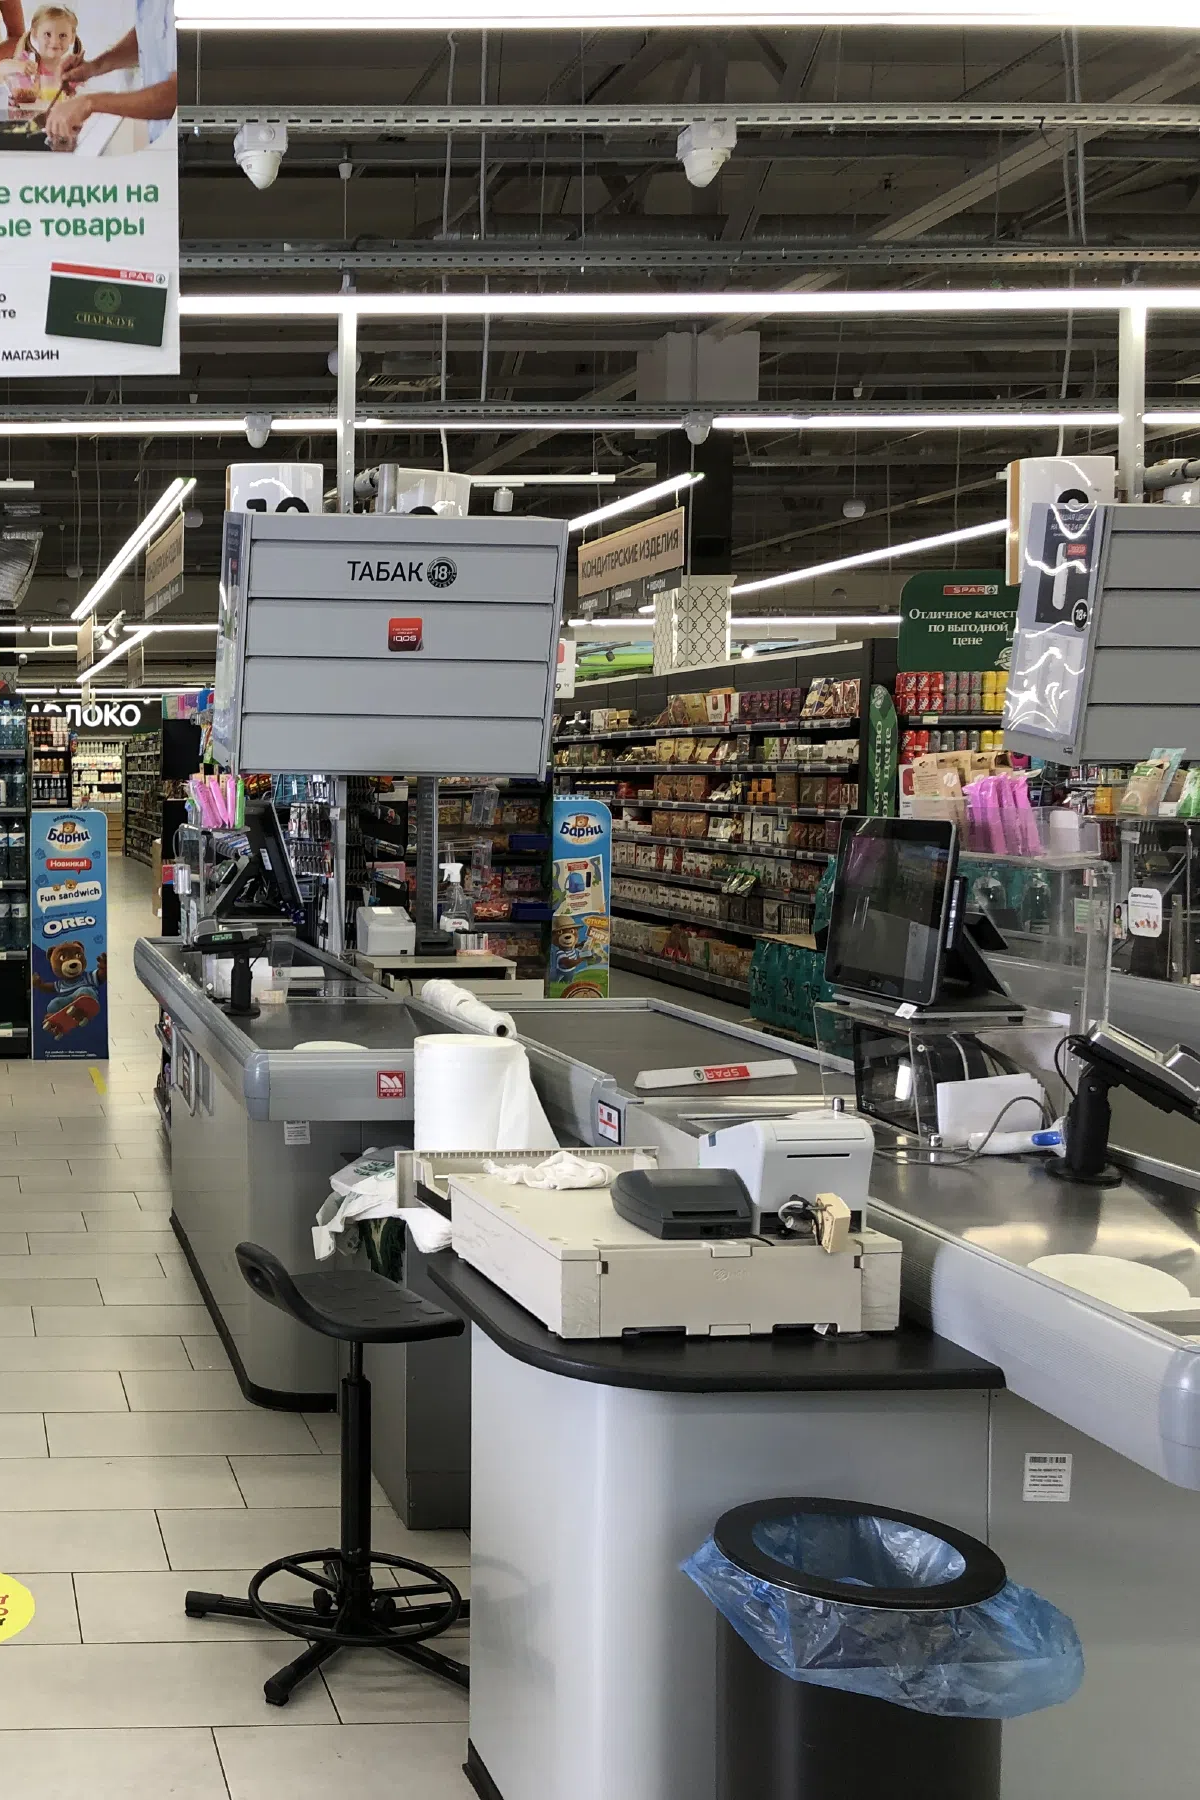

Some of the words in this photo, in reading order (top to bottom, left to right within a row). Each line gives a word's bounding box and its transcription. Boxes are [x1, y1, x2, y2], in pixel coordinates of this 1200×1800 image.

[19, 182, 118, 208] скидки
[126, 183, 159, 203] на
[40, 217, 145, 242] товары
[119, 271, 154, 283] SPAR
[1, 349, 60, 362] МАГАЗИН
[581, 543, 638, 580] КОНДИТЕРСКИЕ
[639, 528, 679, 562] ИЗДЕЛИЯ
[347, 560, 424, 582] ТАБАК
[953, 586, 985, 594] SPAR
[908, 608, 972, 620] Отличное
[1075, 608, 1087, 621] 18+
[928, 624, 945, 632] по
[947, 621, 1009, 634] выгодной
[952, 637, 983, 647] цене
[873, 720, 883, 814] качество
[47, 828, 91, 845] Барни
[560, 821, 604, 839] Барни
[50, 859, 87, 867] Новинка!
[40, 894, 56, 903] Fun
[58, 887, 101, 900] sandwich
[43, 915, 97, 935] OREO
[705, 1068, 740, 1079] SPAR
